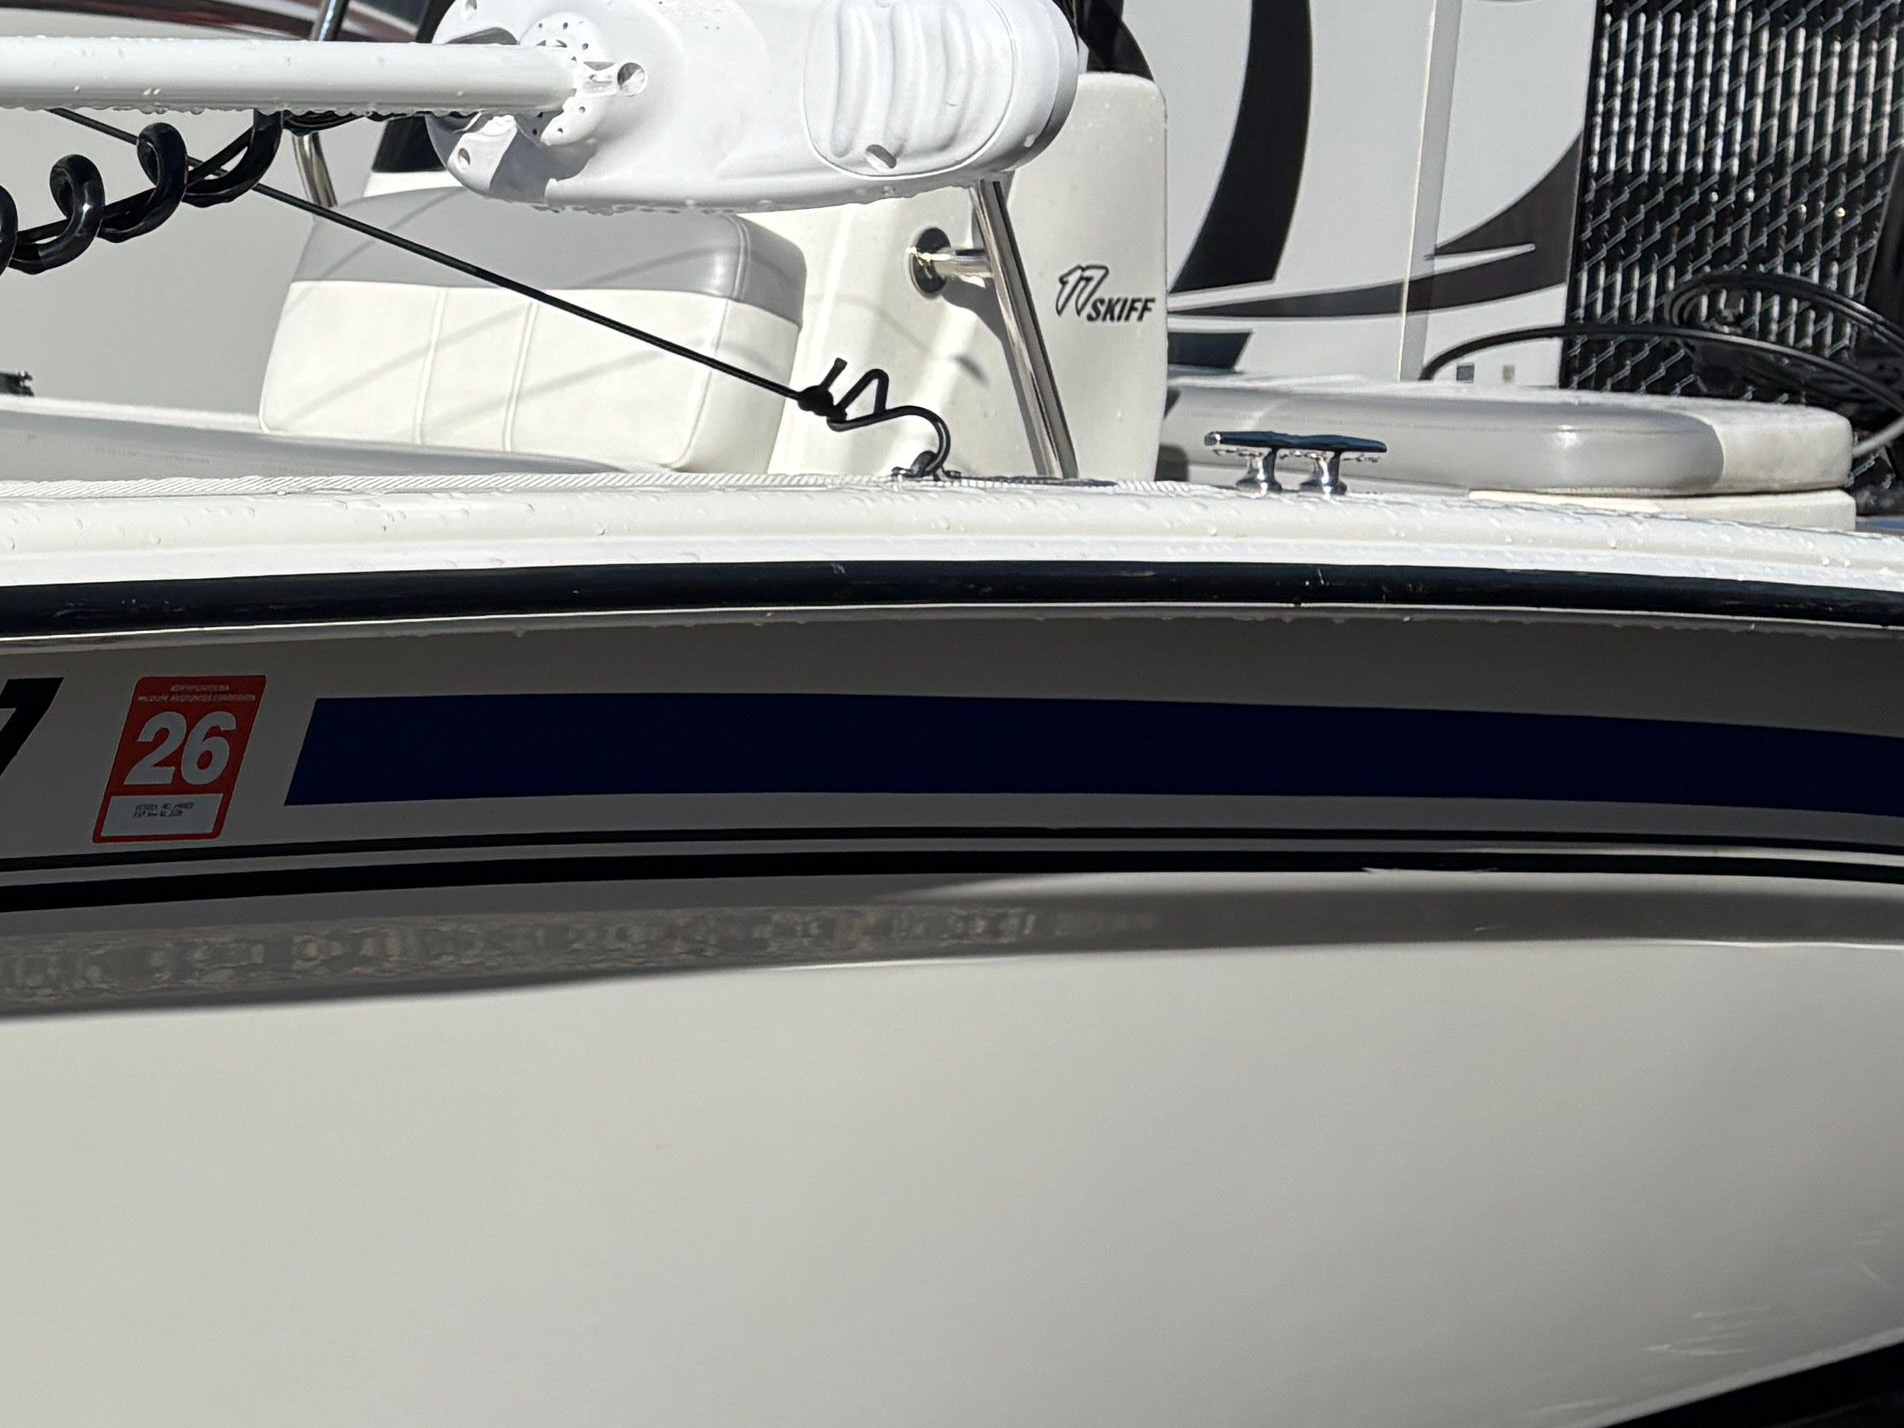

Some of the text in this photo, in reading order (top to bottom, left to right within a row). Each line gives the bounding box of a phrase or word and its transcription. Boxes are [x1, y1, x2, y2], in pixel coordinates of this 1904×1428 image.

[1056, 263, 1109, 317] 17
[1086, 297, 1156, 322] SKIFF
[123, 710, 237, 786] 26
